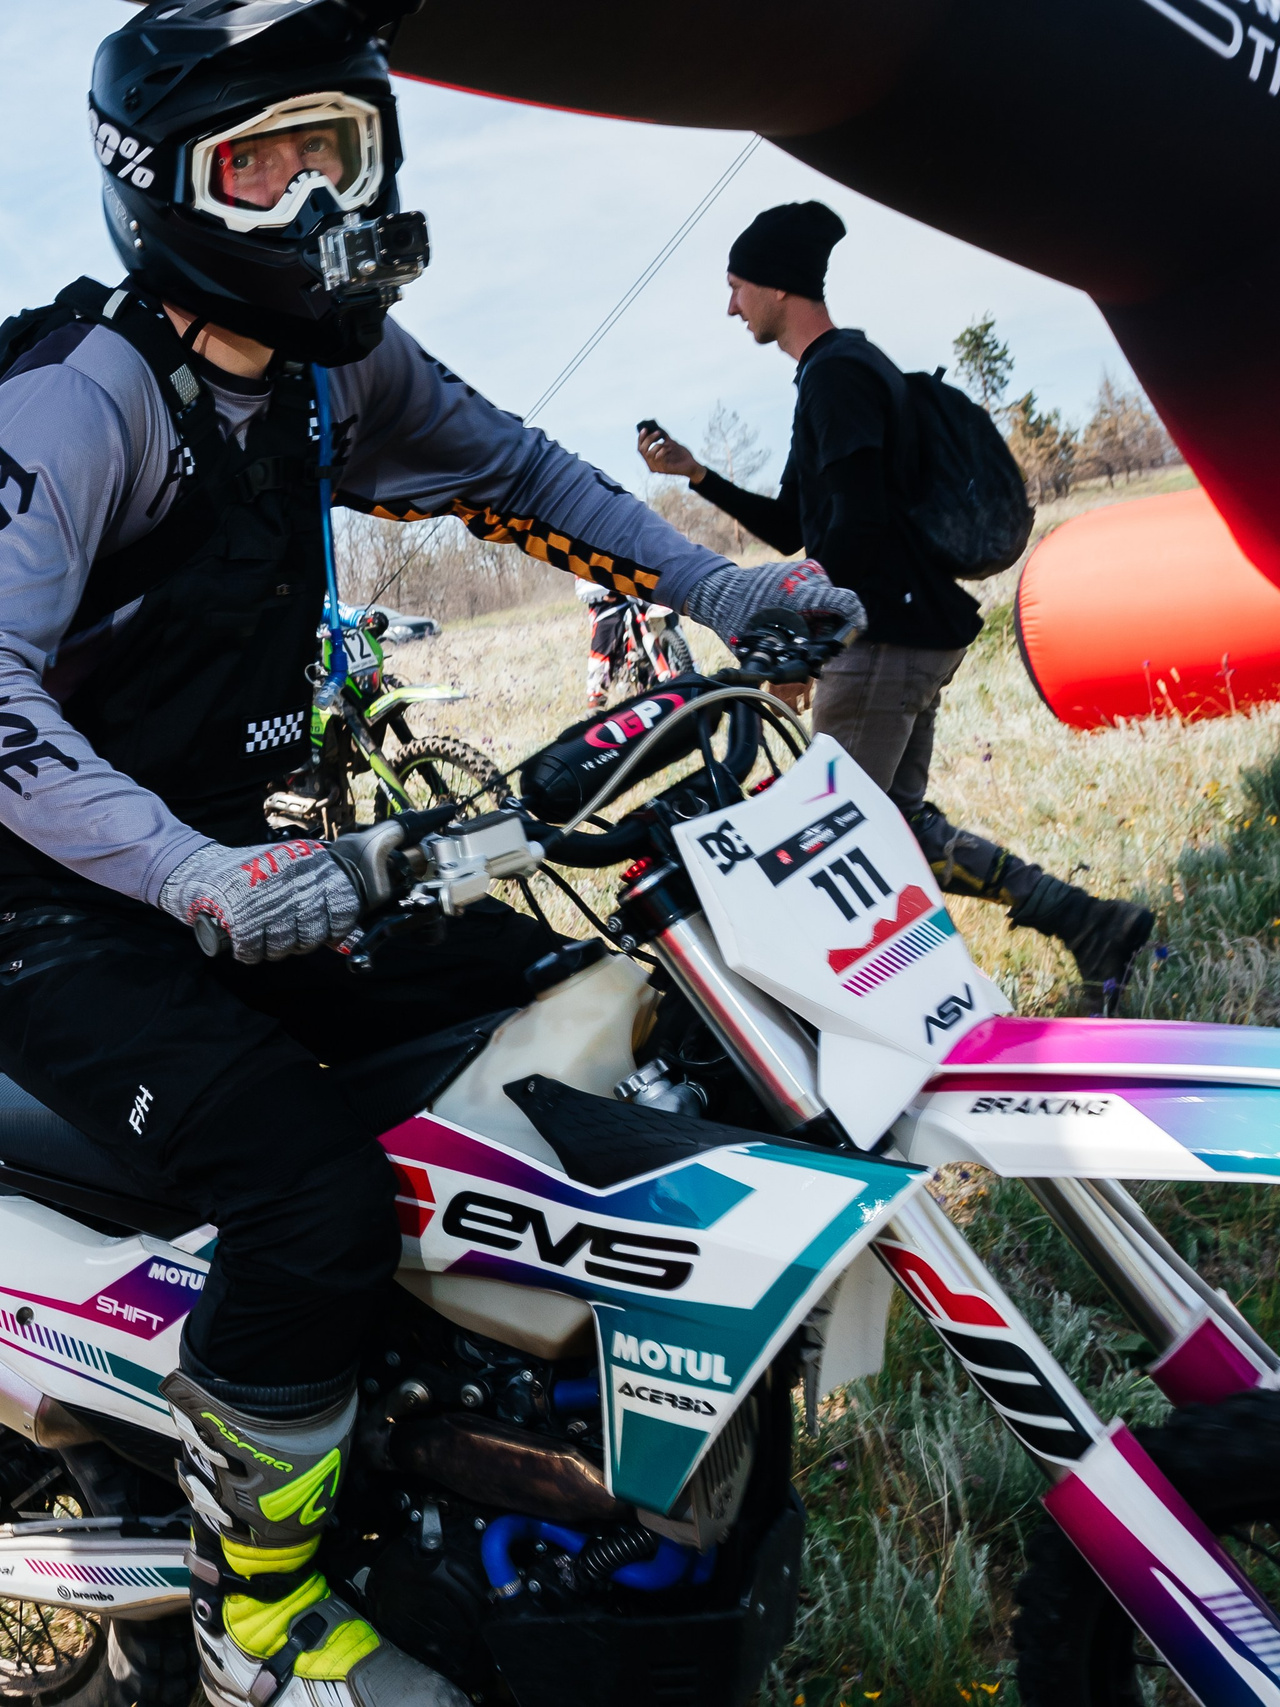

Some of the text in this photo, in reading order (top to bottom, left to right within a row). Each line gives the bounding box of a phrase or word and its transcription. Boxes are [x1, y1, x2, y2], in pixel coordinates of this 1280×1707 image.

[808, 846, 895, 923] 111
[969, 1097, 1110, 1116] BRAKING
[95, 1295, 164, 1331] SHIFT
[611, 1330, 733, 1386] MOTUL
[72, 1590, 115, 1602] brembo
